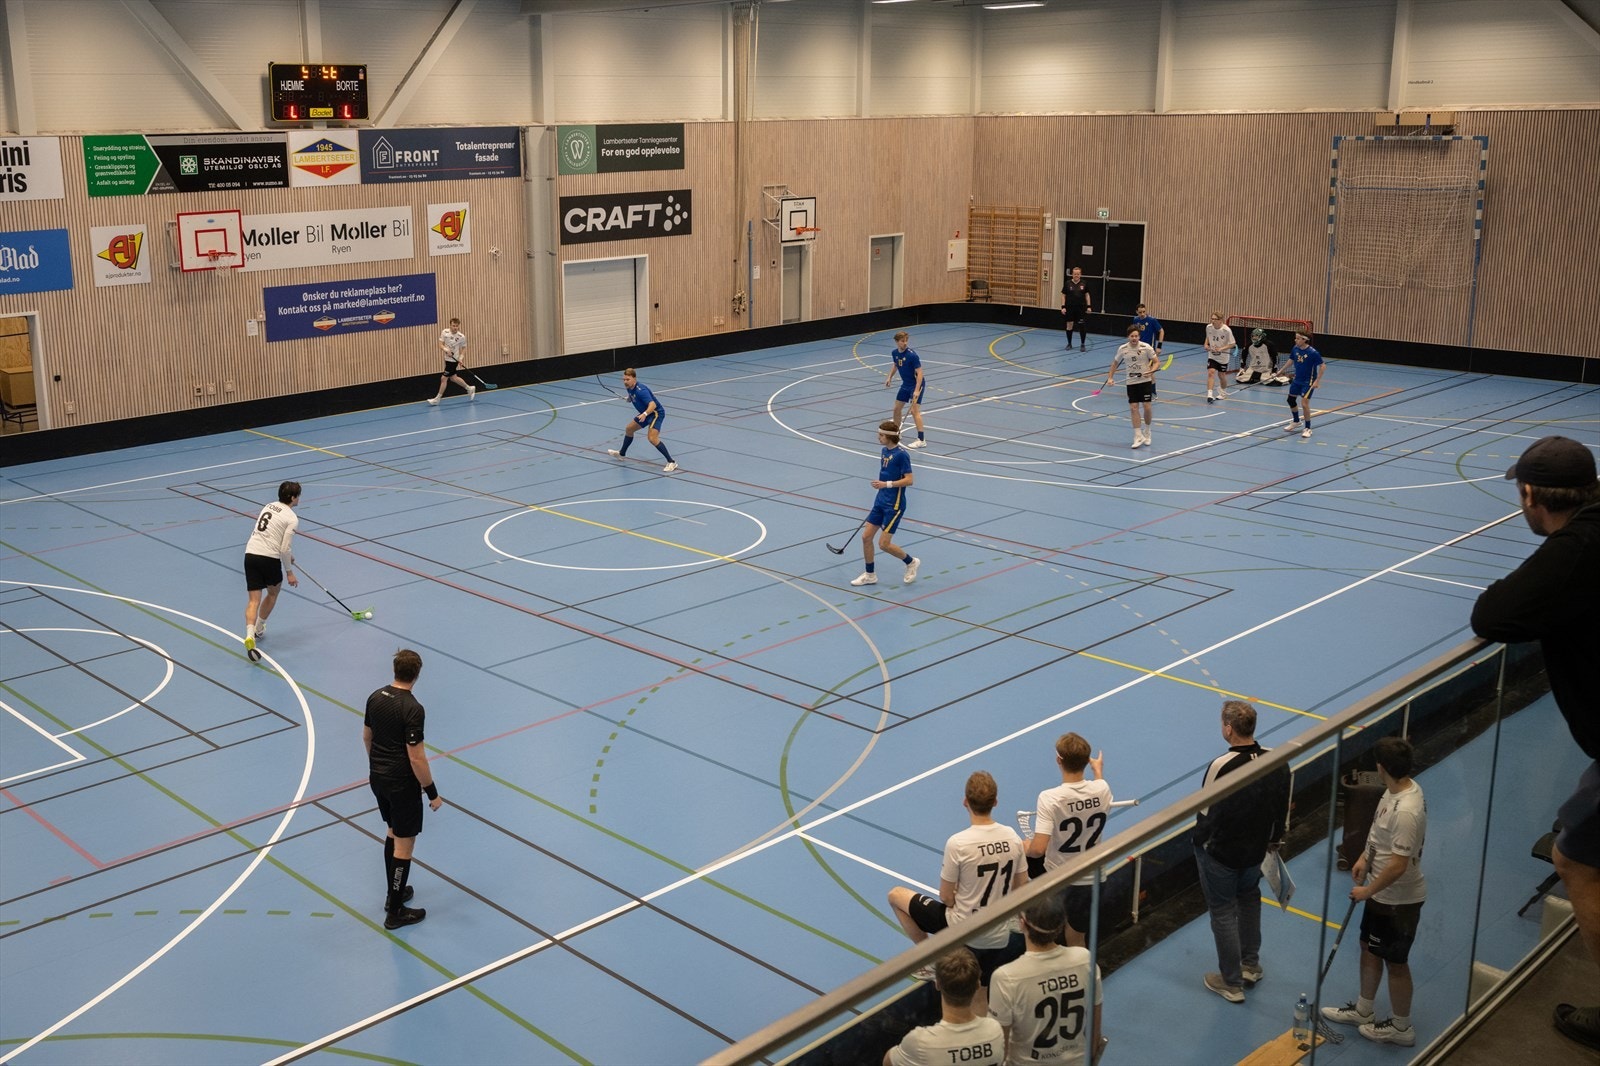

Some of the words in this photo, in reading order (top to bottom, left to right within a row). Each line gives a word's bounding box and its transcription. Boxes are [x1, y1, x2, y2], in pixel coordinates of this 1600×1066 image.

[280, 80, 304, 90] HJEMME
[336, 80, 359, 90] BORTE
[0, 140, 30, 166] ini
[455, 142, 515, 151] Totalentreprenør
[626, 147, 640, 158] god
[641, 146, 680, 157] opplevelse
[203, 155, 281, 165] SKANDINAVISK
[294, 153, 355, 163] LAMBERTSETER
[396, 150, 440, 163] FRONT
[475, 153, 499, 162] fasade
[564, 203, 662, 234] CRAFT
[306, 224, 324, 243] Bil
[393, 219, 409, 237] Bil
[331, 245, 351, 255] Ryen
[302, 292, 328, 302] Ønsker
[329, 290, 339, 299] du
[340, 285, 386, 298] reklameplass
[387, 284, 402, 294] her?
[278, 304, 307, 316] Kontakt
[322, 301, 332, 313] på
[333, 293, 425, 311] marked@lambertseterif.no
[338, 315, 372, 323] LAMBERTSETER
[258, 512, 272, 532] 6
[1068, 797, 1100, 812] TOBB
[1059, 812, 1107, 853] 22
[978, 841, 1010, 856] TOBB
[977, 860, 1014, 906] 71
[1038, 974, 1079, 995] TOBB
[1034, 989, 1085, 1048] 25
[948, 1043, 993, 1063] TOBB
